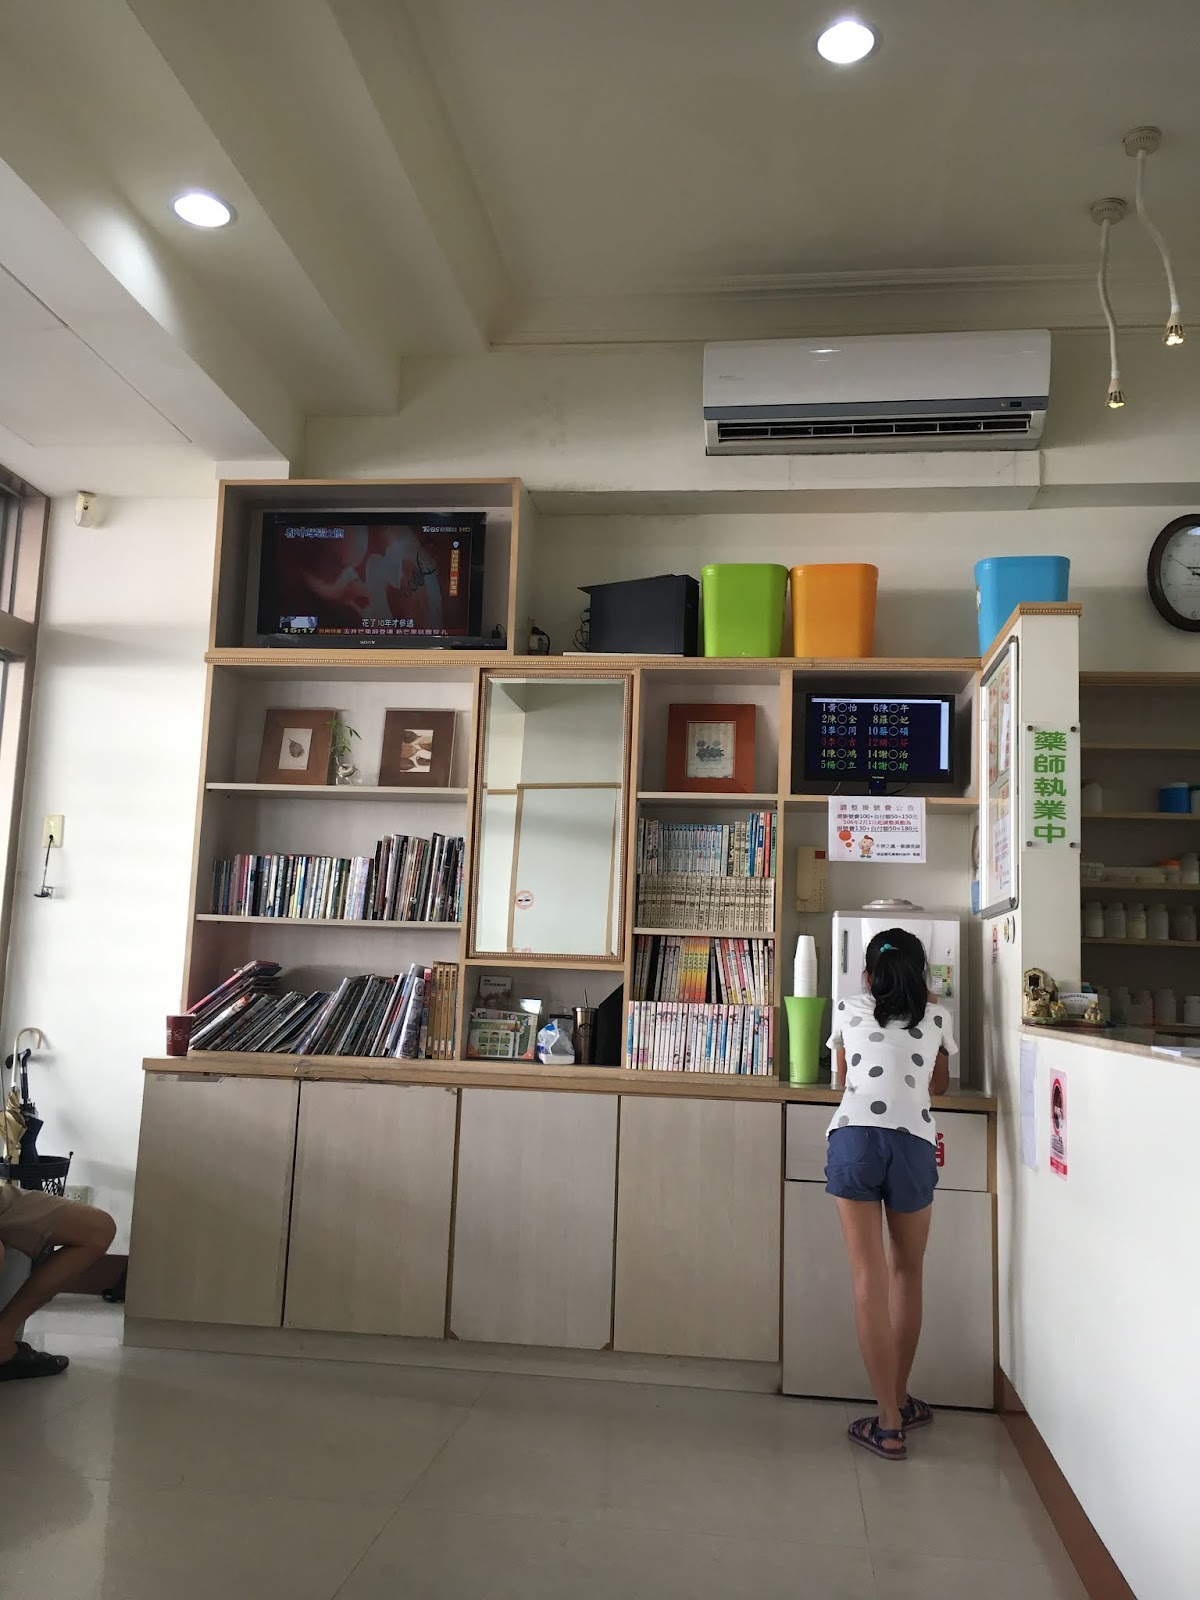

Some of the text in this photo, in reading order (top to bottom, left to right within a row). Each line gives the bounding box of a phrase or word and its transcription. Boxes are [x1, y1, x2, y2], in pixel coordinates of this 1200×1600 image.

[1033, 731, 1067, 843] 藥師執業中
